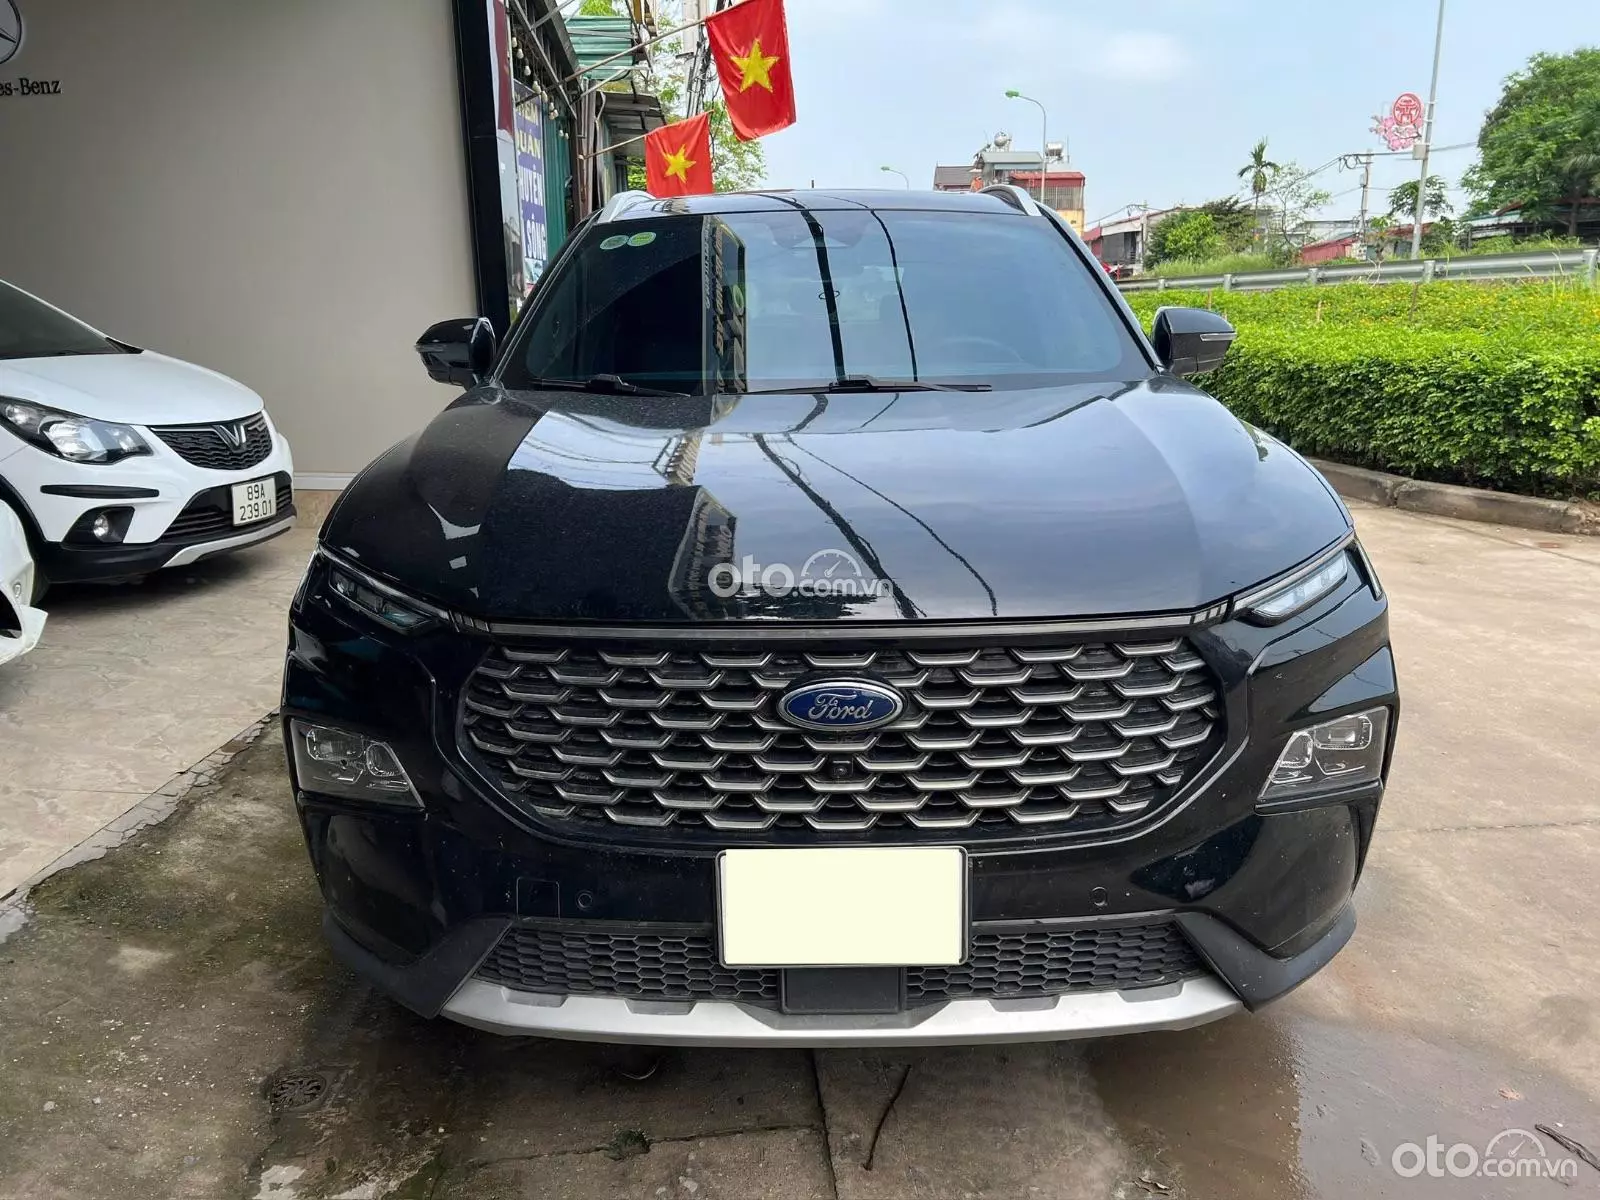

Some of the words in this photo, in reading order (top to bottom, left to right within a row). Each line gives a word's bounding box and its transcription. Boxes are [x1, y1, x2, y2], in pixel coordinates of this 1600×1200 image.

[247, 483, 265, 501] 89A
[239, 499, 272, 521] 239.01
[807, 691, 874, 720] Ford
